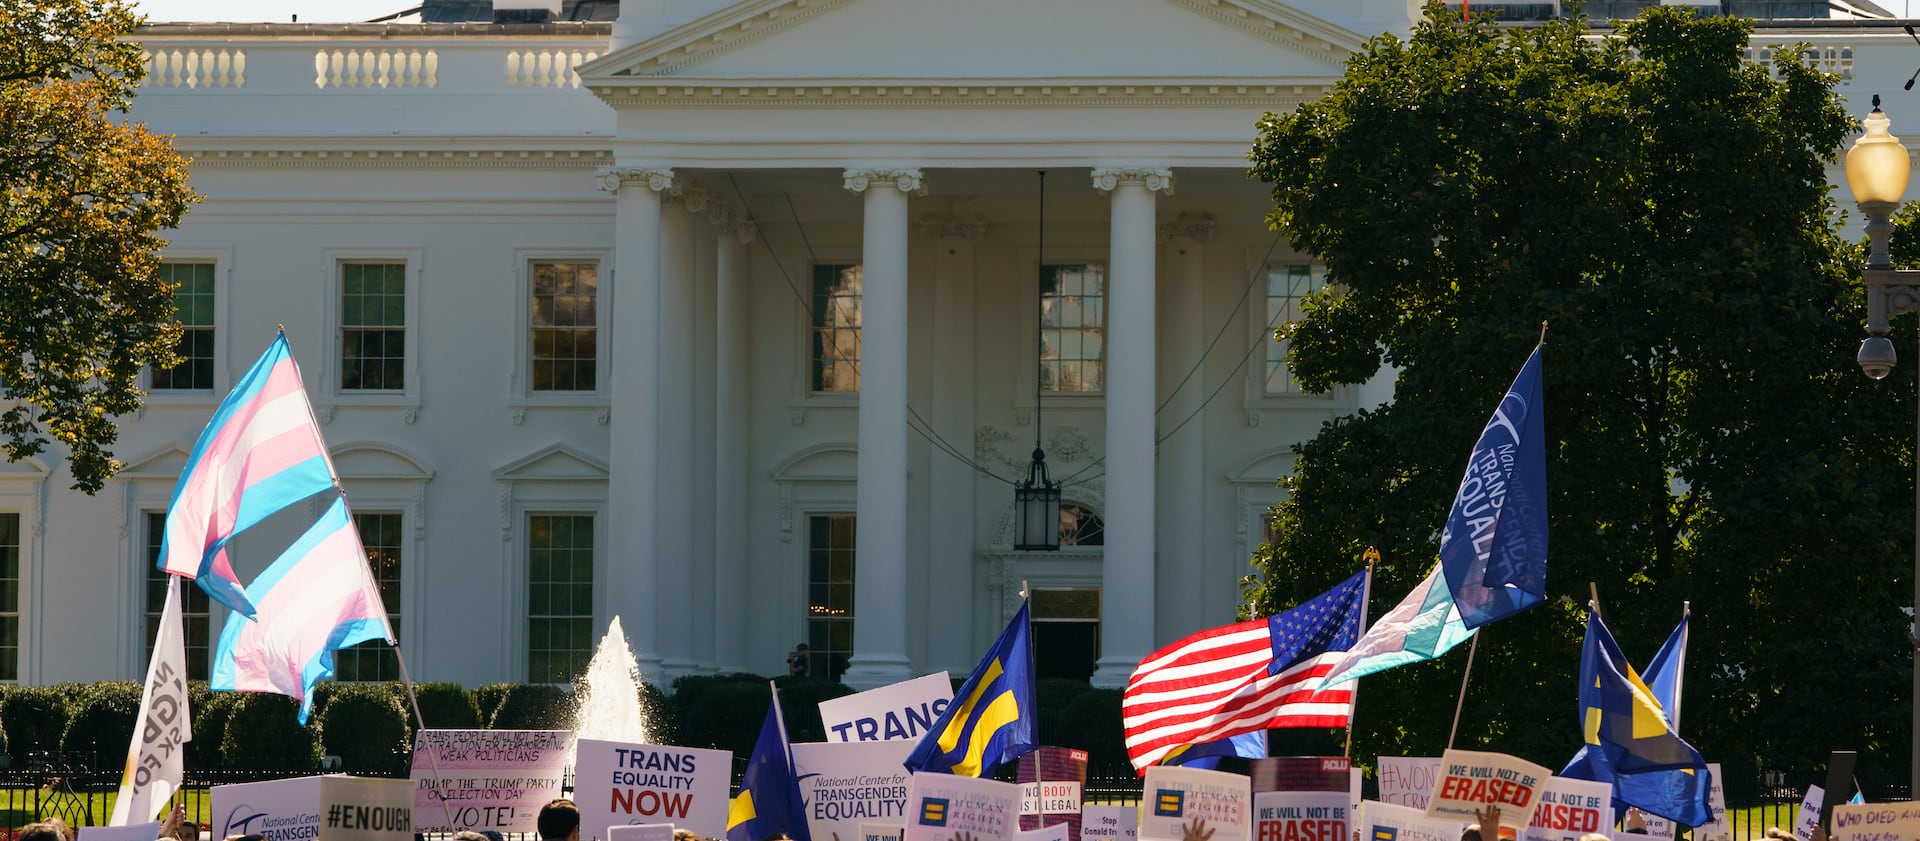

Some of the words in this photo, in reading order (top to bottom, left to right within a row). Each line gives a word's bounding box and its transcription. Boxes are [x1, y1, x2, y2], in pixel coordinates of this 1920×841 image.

[831, 698, 950, 743] TRANS
[454, 731, 486, 741] PEOPLE
[493, 731, 513, 741] WILL
[514, 732, 529, 741] NOT
[534, 732, 546, 741] BE
[417, 740, 485, 751] DITRACTION
[485, 740, 499, 750] FOR
[440, 751, 468, 761] WEAK
[475, 750, 540, 762] POLITICIANS
[615, 748, 696, 774] TRANS
[1070, 751, 1087, 761] ACLU
[1323, 760, 1348, 770] ACLU
[612, 771, 694, 790] EQUALITY
[814, 775, 857, 788] National
[858, 775, 890, 787] Center
[890, 774, 907, 787] for
[1449, 764, 1468, 776] WE
[1470, 766, 1493, 778] WILL
[1496, 768, 1521, 781] NOT
[1522, 774, 1538, 788] BE
[457, 779, 478, 789] THE
[483, 779, 524, 789] TRUMP
[526, 778, 557, 789] PARTY
[447, 789, 501, 800] ELECTION
[505, 789, 526, 800] DAY
[813, 786, 907, 801] TRANSGENDER
[1025, 786, 1039, 798] NO
[1044, 786, 1072, 797] BODY
[1190, 791, 1238, 803] HUMAN
[1440, 776, 1533, 808] ERASED
[611, 787, 693, 819] NOW
[955, 799, 1004, 813] HUMAN
[1020, 801, 1030, 811] IS
[1034, 799, 1077, 811] ILEGAL
[1561, 793, 1583, 806] NOT
[1587, 796, 1601, 808] BE
[815, 799, 907, 821] EQUALITY
[1189, 802, 1237, 814] RIGHTS
[1260, 807, 1274, 819] WE
[1277, 807, 1302, 819] WILL
[1306, 807, 1329, 819] NOT
[1333, 807, 1345, 819] BE
[262, 814, 298, 828] National
[328, 804, 410, 832] #ENOUGH
[953, 811, 1001, 825] RIGHTS
[1102, 816, 1117, 826] Stop
[1529, 803, 1600, 833] RASED
[1836, 811, 1862, 828] WHO
[1866, 810, 1896, 824] DIED
[261, 826, 319, 841] TRANSGEN
[1085, 827, 1107, 836] Donald
[1258, 820, 1346, 841] ERASED
